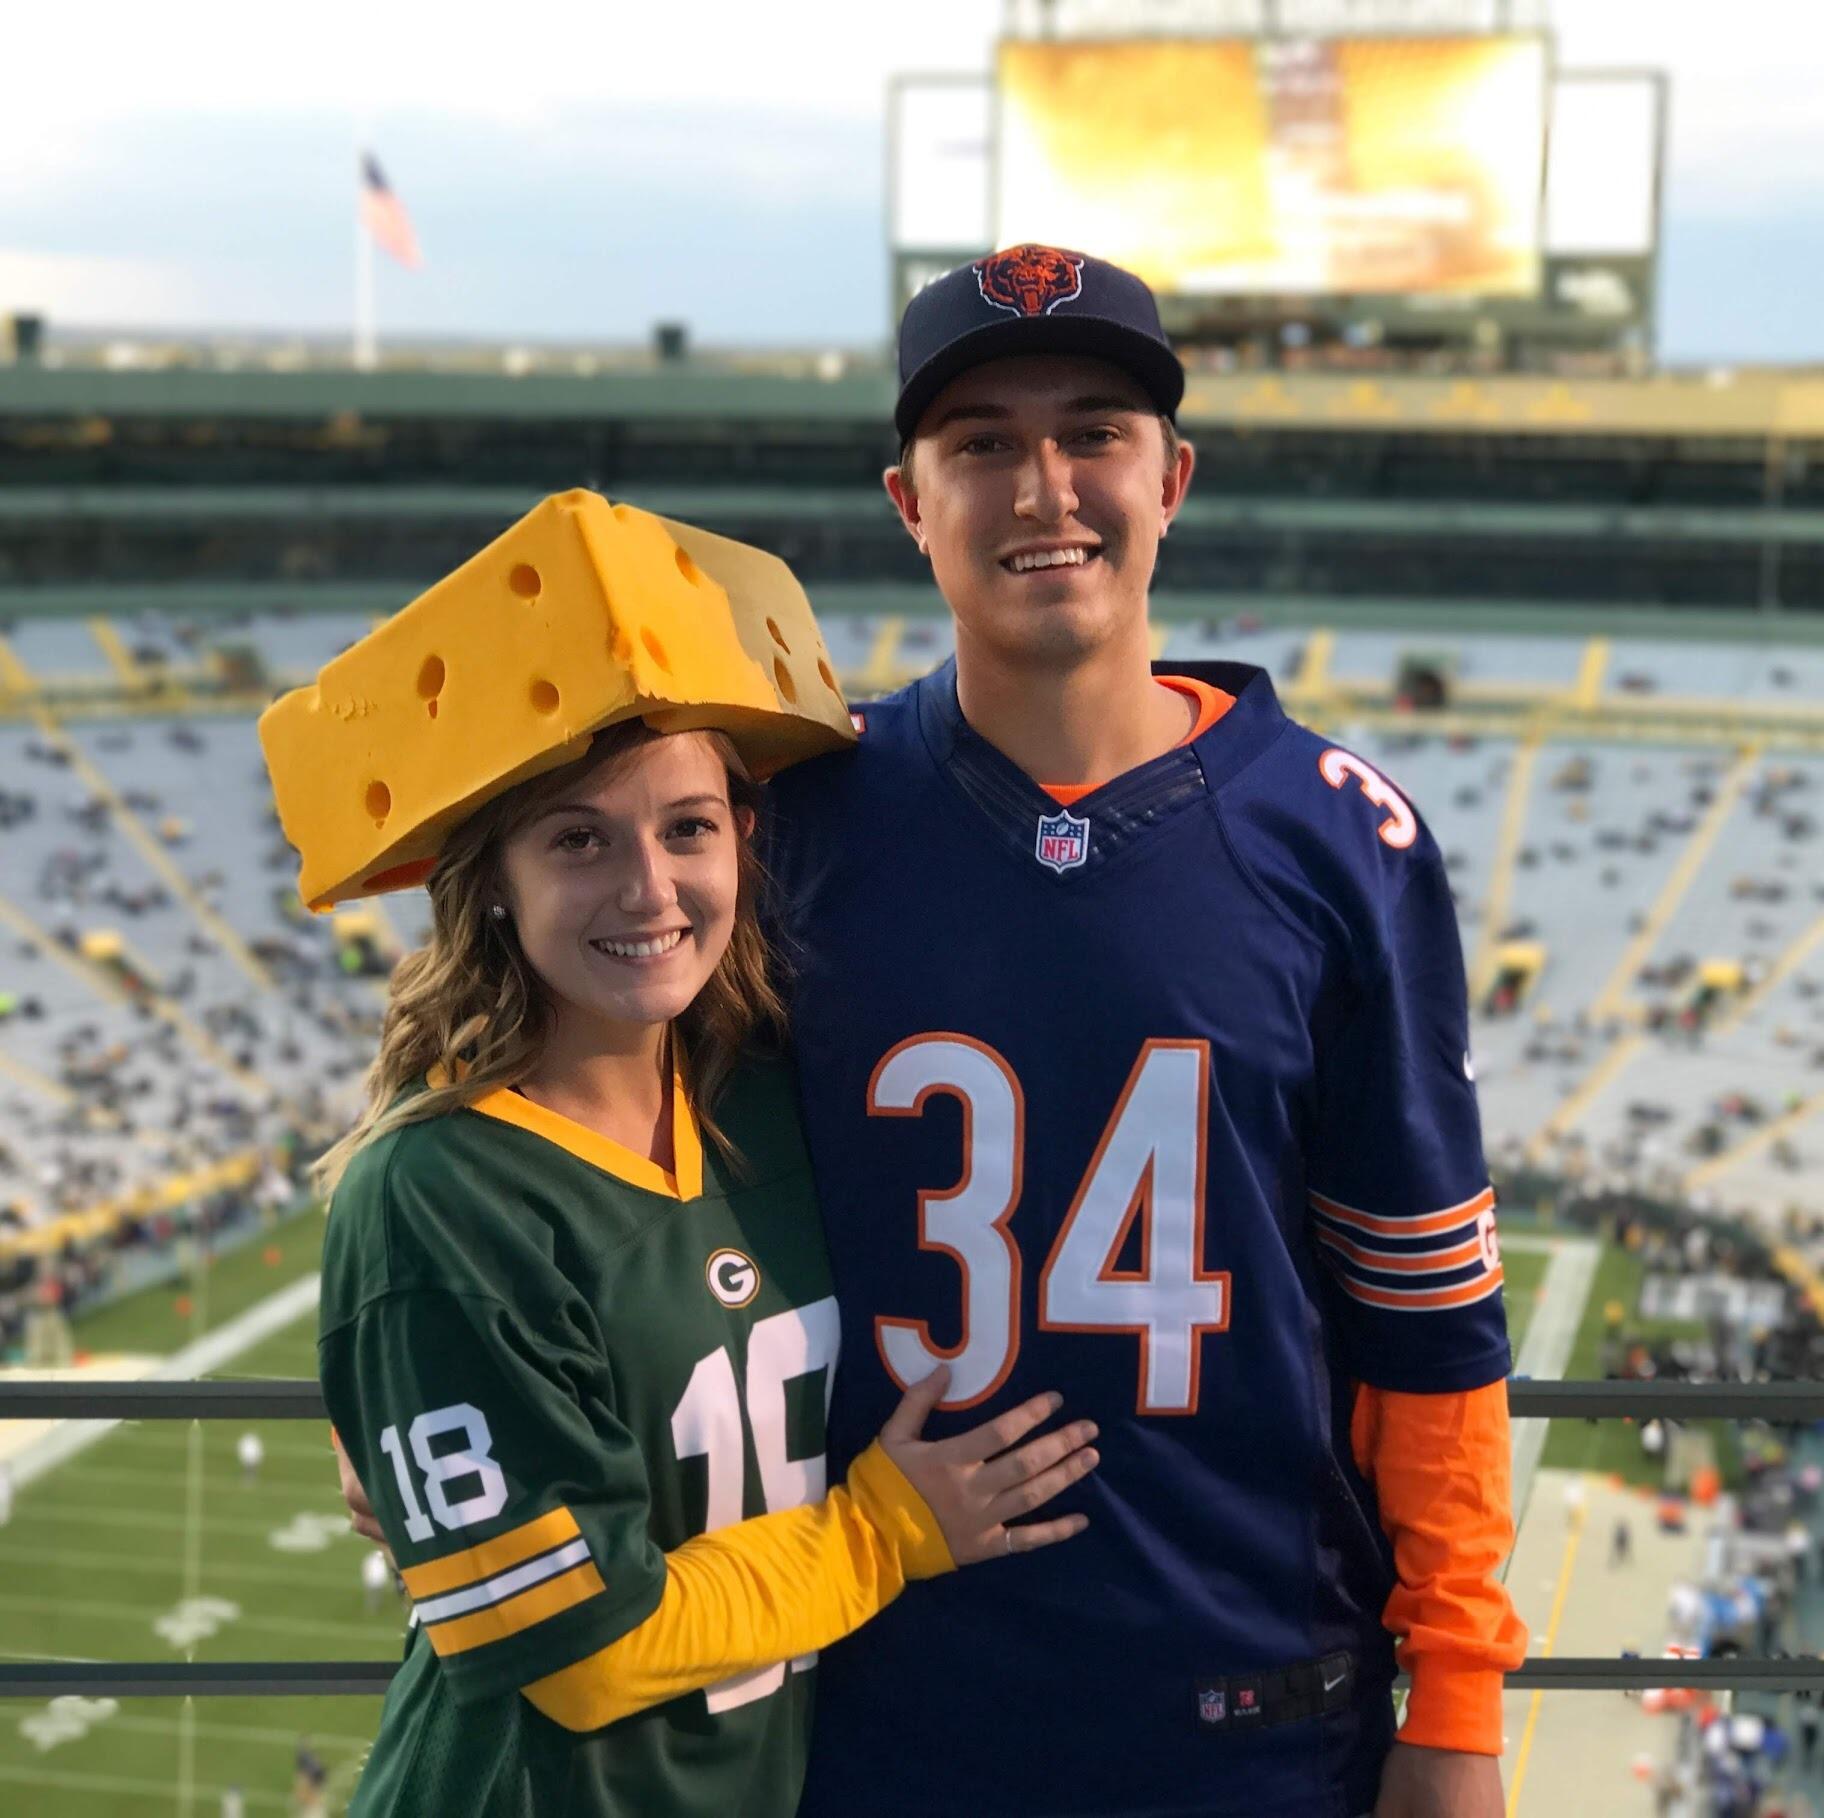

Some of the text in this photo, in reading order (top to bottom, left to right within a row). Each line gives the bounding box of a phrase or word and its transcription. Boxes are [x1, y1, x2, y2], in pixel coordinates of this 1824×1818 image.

[1043, 838, 1079, 861] NFL
[866, 1031, 1231, 1416] 34
[708, 1252, 757, 1304] G
[380, 1402, 508, 1544] 18
